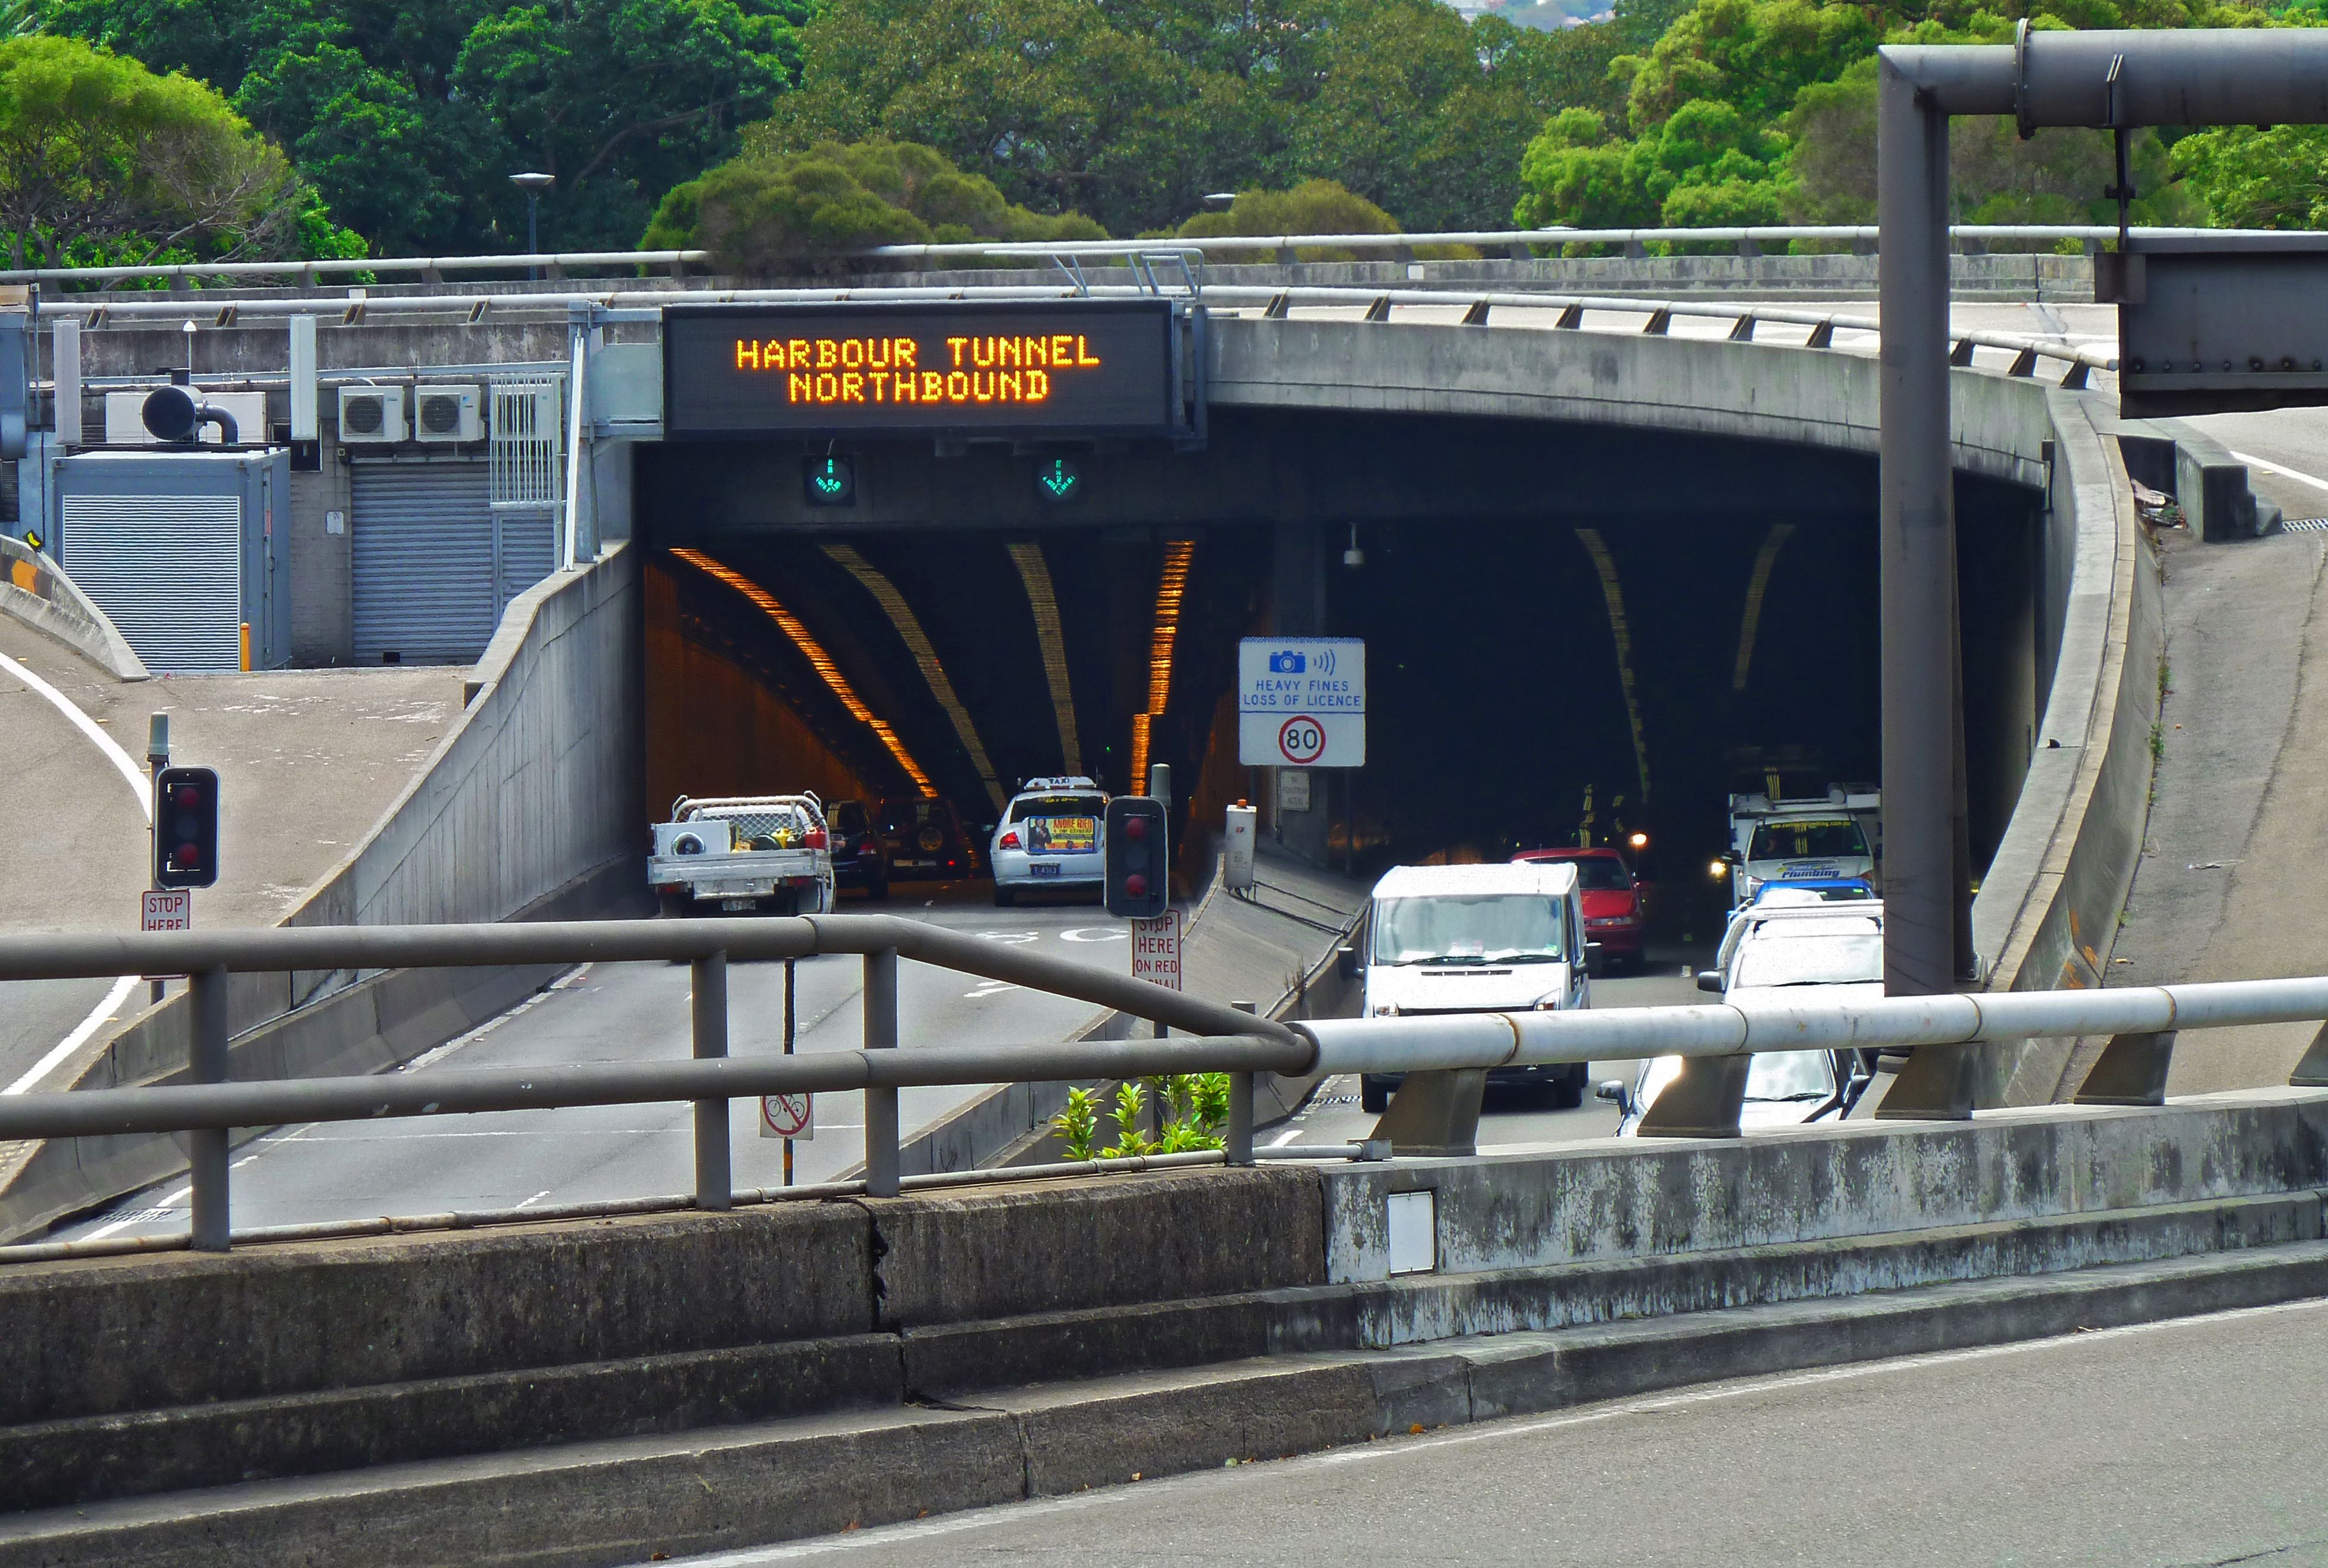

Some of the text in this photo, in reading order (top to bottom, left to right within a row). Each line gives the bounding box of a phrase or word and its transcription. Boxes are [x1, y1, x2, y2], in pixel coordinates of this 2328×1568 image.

[737, 335, 1100, 368] HARBOUR TUNNEL
[789, 368, 1048, 402] NORTHBOUND
[1256, 680, 1349, 692] HEAVY FINES
[1244, 694, 1361, 706] LOSS OF LICENCE
[1286, 729, 1318, 749] 80
[1781, 869, 1840, 878] Plumbing
[149, 897, 183, 913] STOP
[148, 919, 183, 930] HERE
[1138, 937, 1174, 954] HERE
[1135, 959, 1178, 973] ON RED
